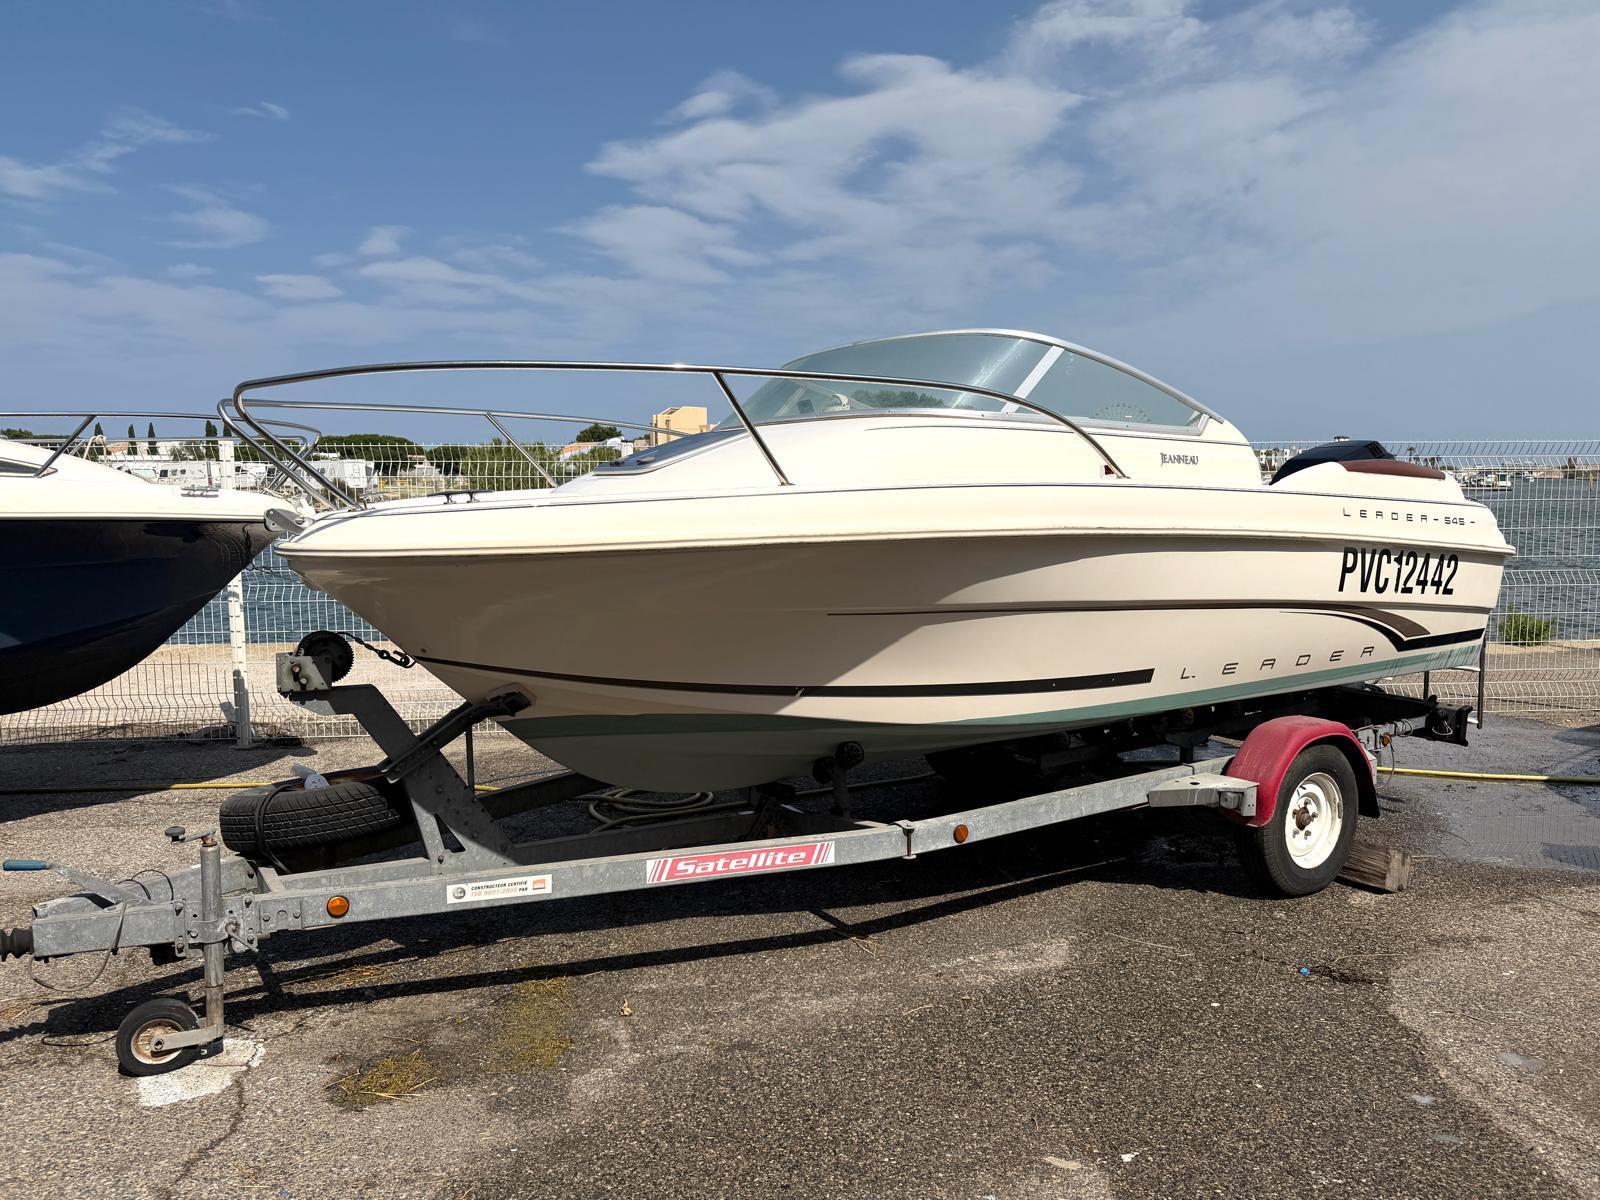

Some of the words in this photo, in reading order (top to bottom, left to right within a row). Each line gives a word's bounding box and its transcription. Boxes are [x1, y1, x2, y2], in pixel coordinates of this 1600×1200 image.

[1160, 452, 1199, 467] JEANNEAU
[1338, 546, 1459, 596] PVC12442
[1180, 646, 1375, 680] LEADER
[674, 851, 807, 876] Satellite
[471, 882, 506, 891] CONSTRUCTEUR
